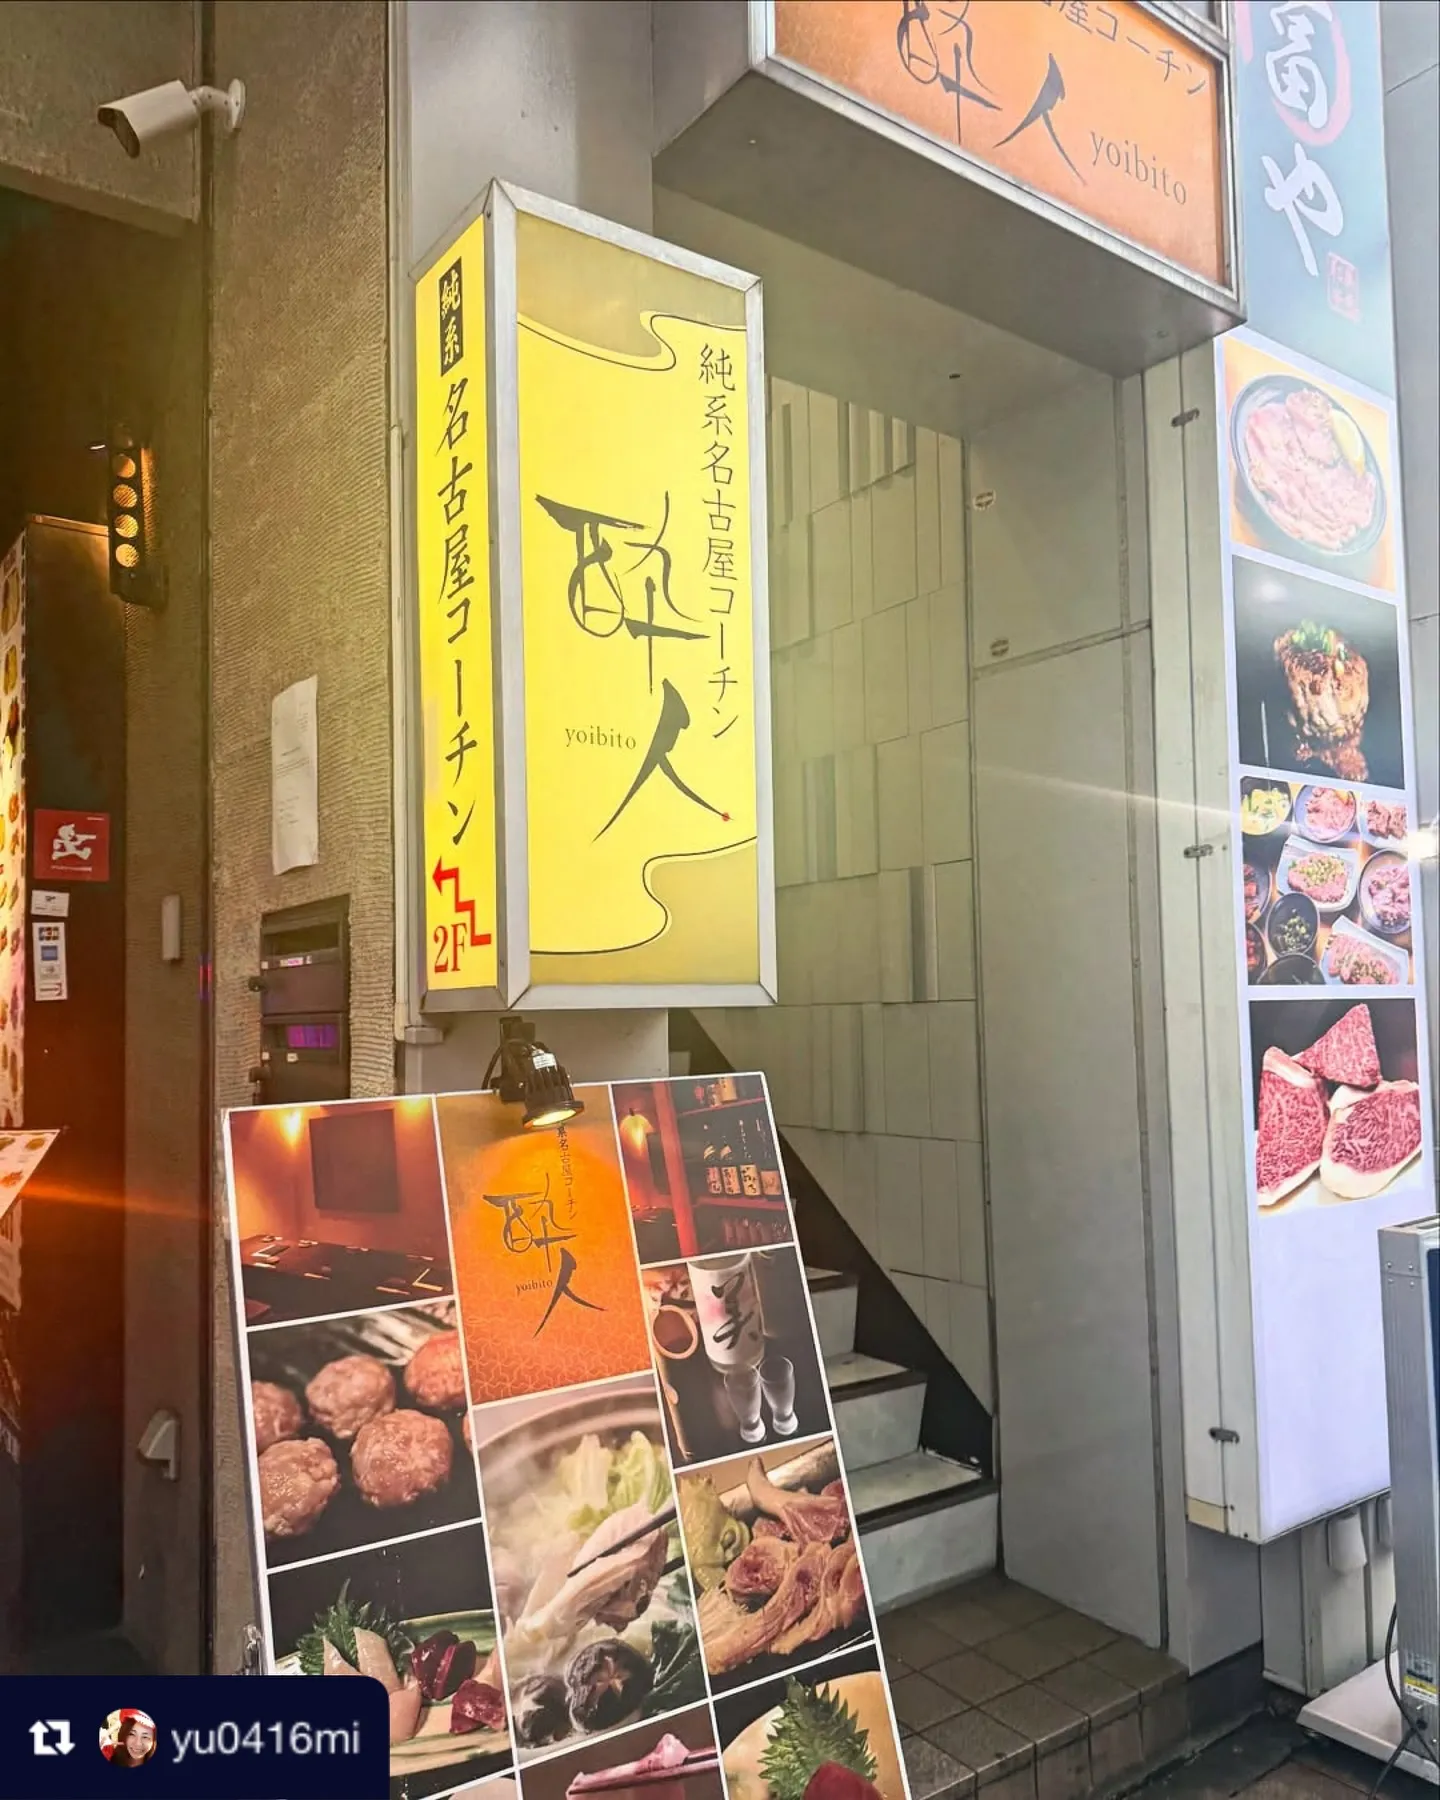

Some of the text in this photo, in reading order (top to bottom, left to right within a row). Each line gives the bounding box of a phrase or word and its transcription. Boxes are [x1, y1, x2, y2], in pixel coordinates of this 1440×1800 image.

[1090, 130, 1187, 206] yoibito
[698, 342, 740, 739] 純系名古屋コーチン
[565, 725, 638, 751] yoibito
[432, 922, 468, 974] 2F
[515, 1278, 554, 1296] yoibito
